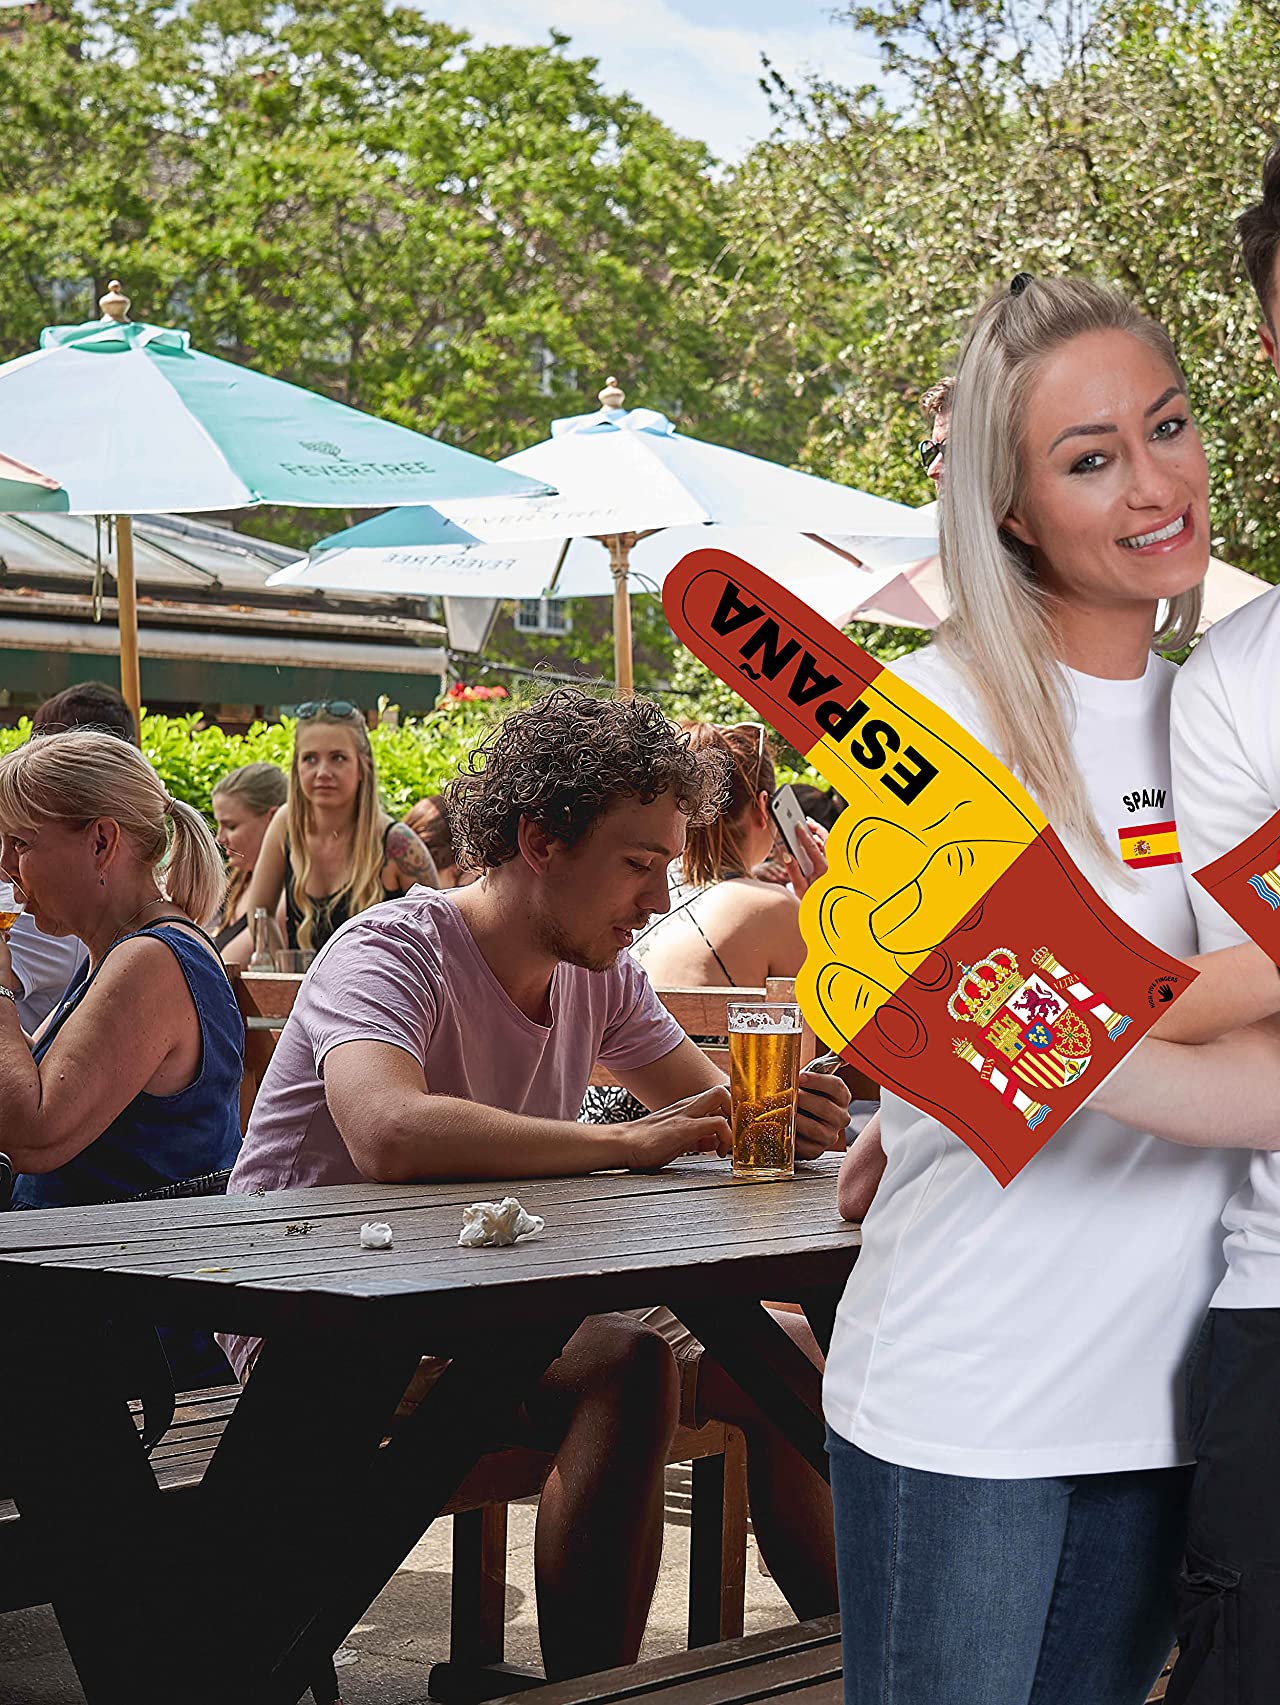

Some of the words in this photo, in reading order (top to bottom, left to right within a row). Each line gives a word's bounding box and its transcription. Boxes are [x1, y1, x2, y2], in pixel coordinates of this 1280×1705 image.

[279, 461, 436, 477] FEVER-TREE
[710, 579, 940, 806] ESPAÑA
[1122, 788, 1167, 812] SPAIN
[1052, 973, 1080, 991] VLTRA
[1147, 995, 1156, 1009] HIGH
[1155, 976, 1178, 984] FINGERS
[980, 1056, 996, 1080] PLVS
